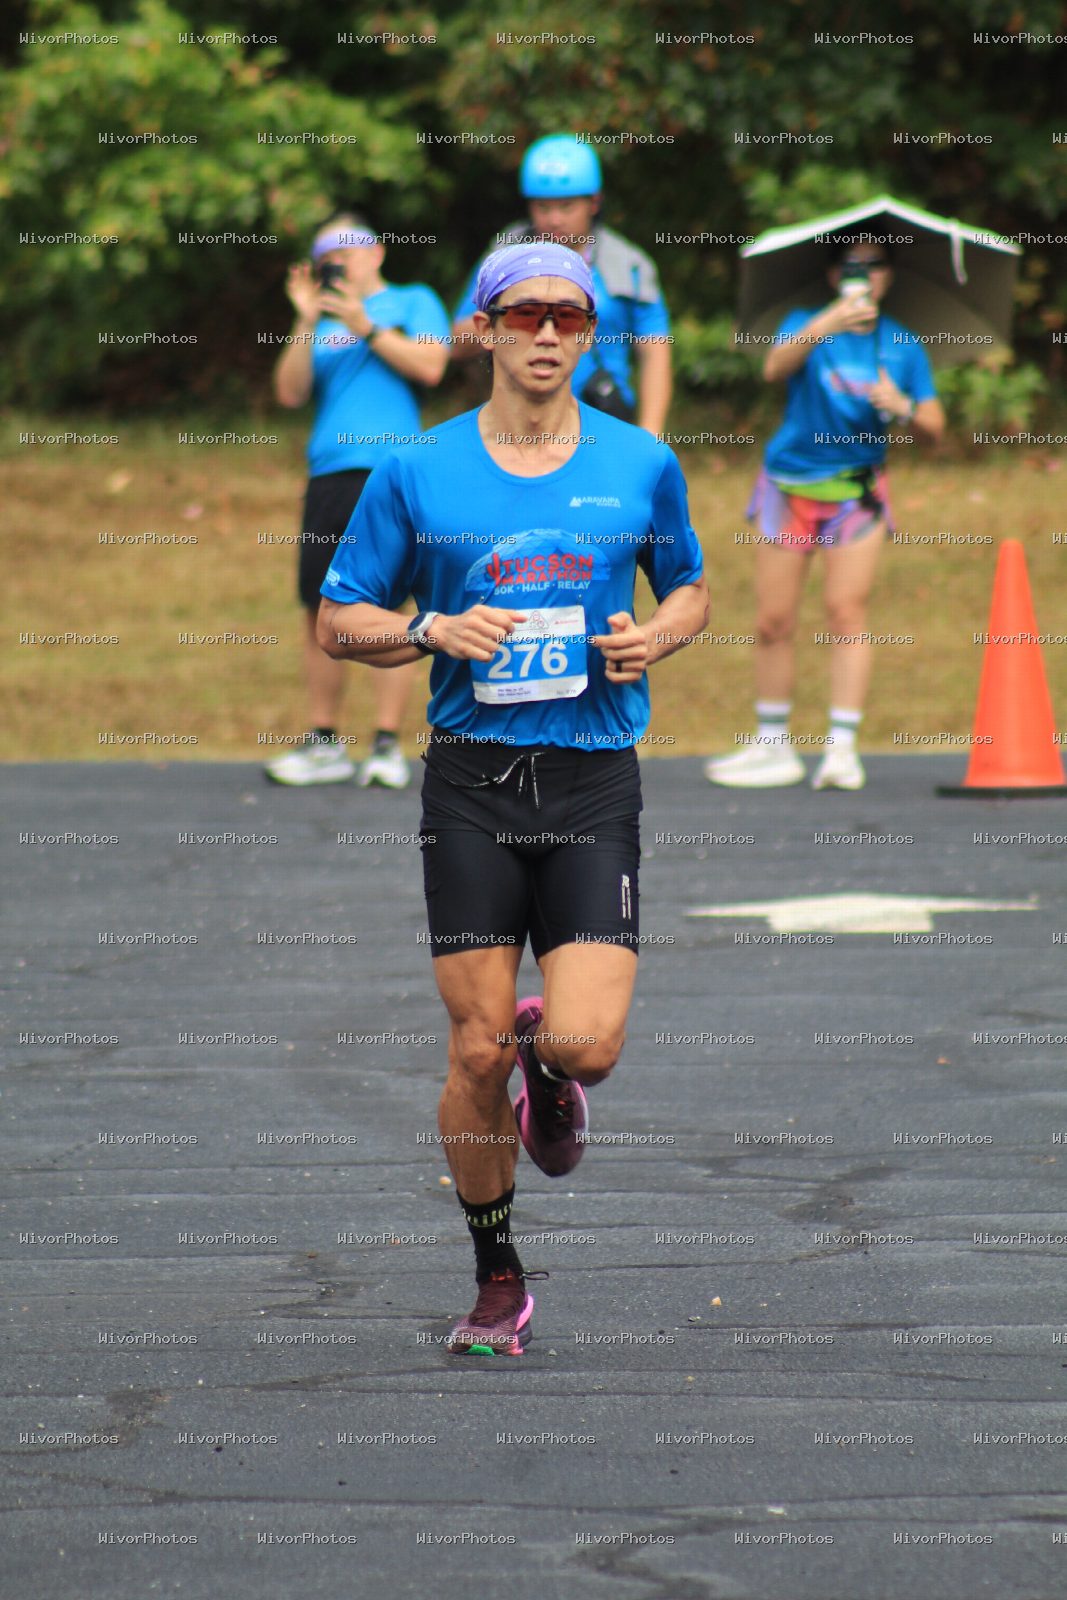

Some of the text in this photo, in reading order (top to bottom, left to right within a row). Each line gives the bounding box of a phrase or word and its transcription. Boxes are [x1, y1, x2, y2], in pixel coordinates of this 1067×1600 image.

[501, 553, 594, 575] TUCSON
[501, 569, 593, 585] MARATHON
[521, 582, 551, 593] HALF
[557, 580, 591, 591] RELAY
[487, 641, 569, 679] 276
